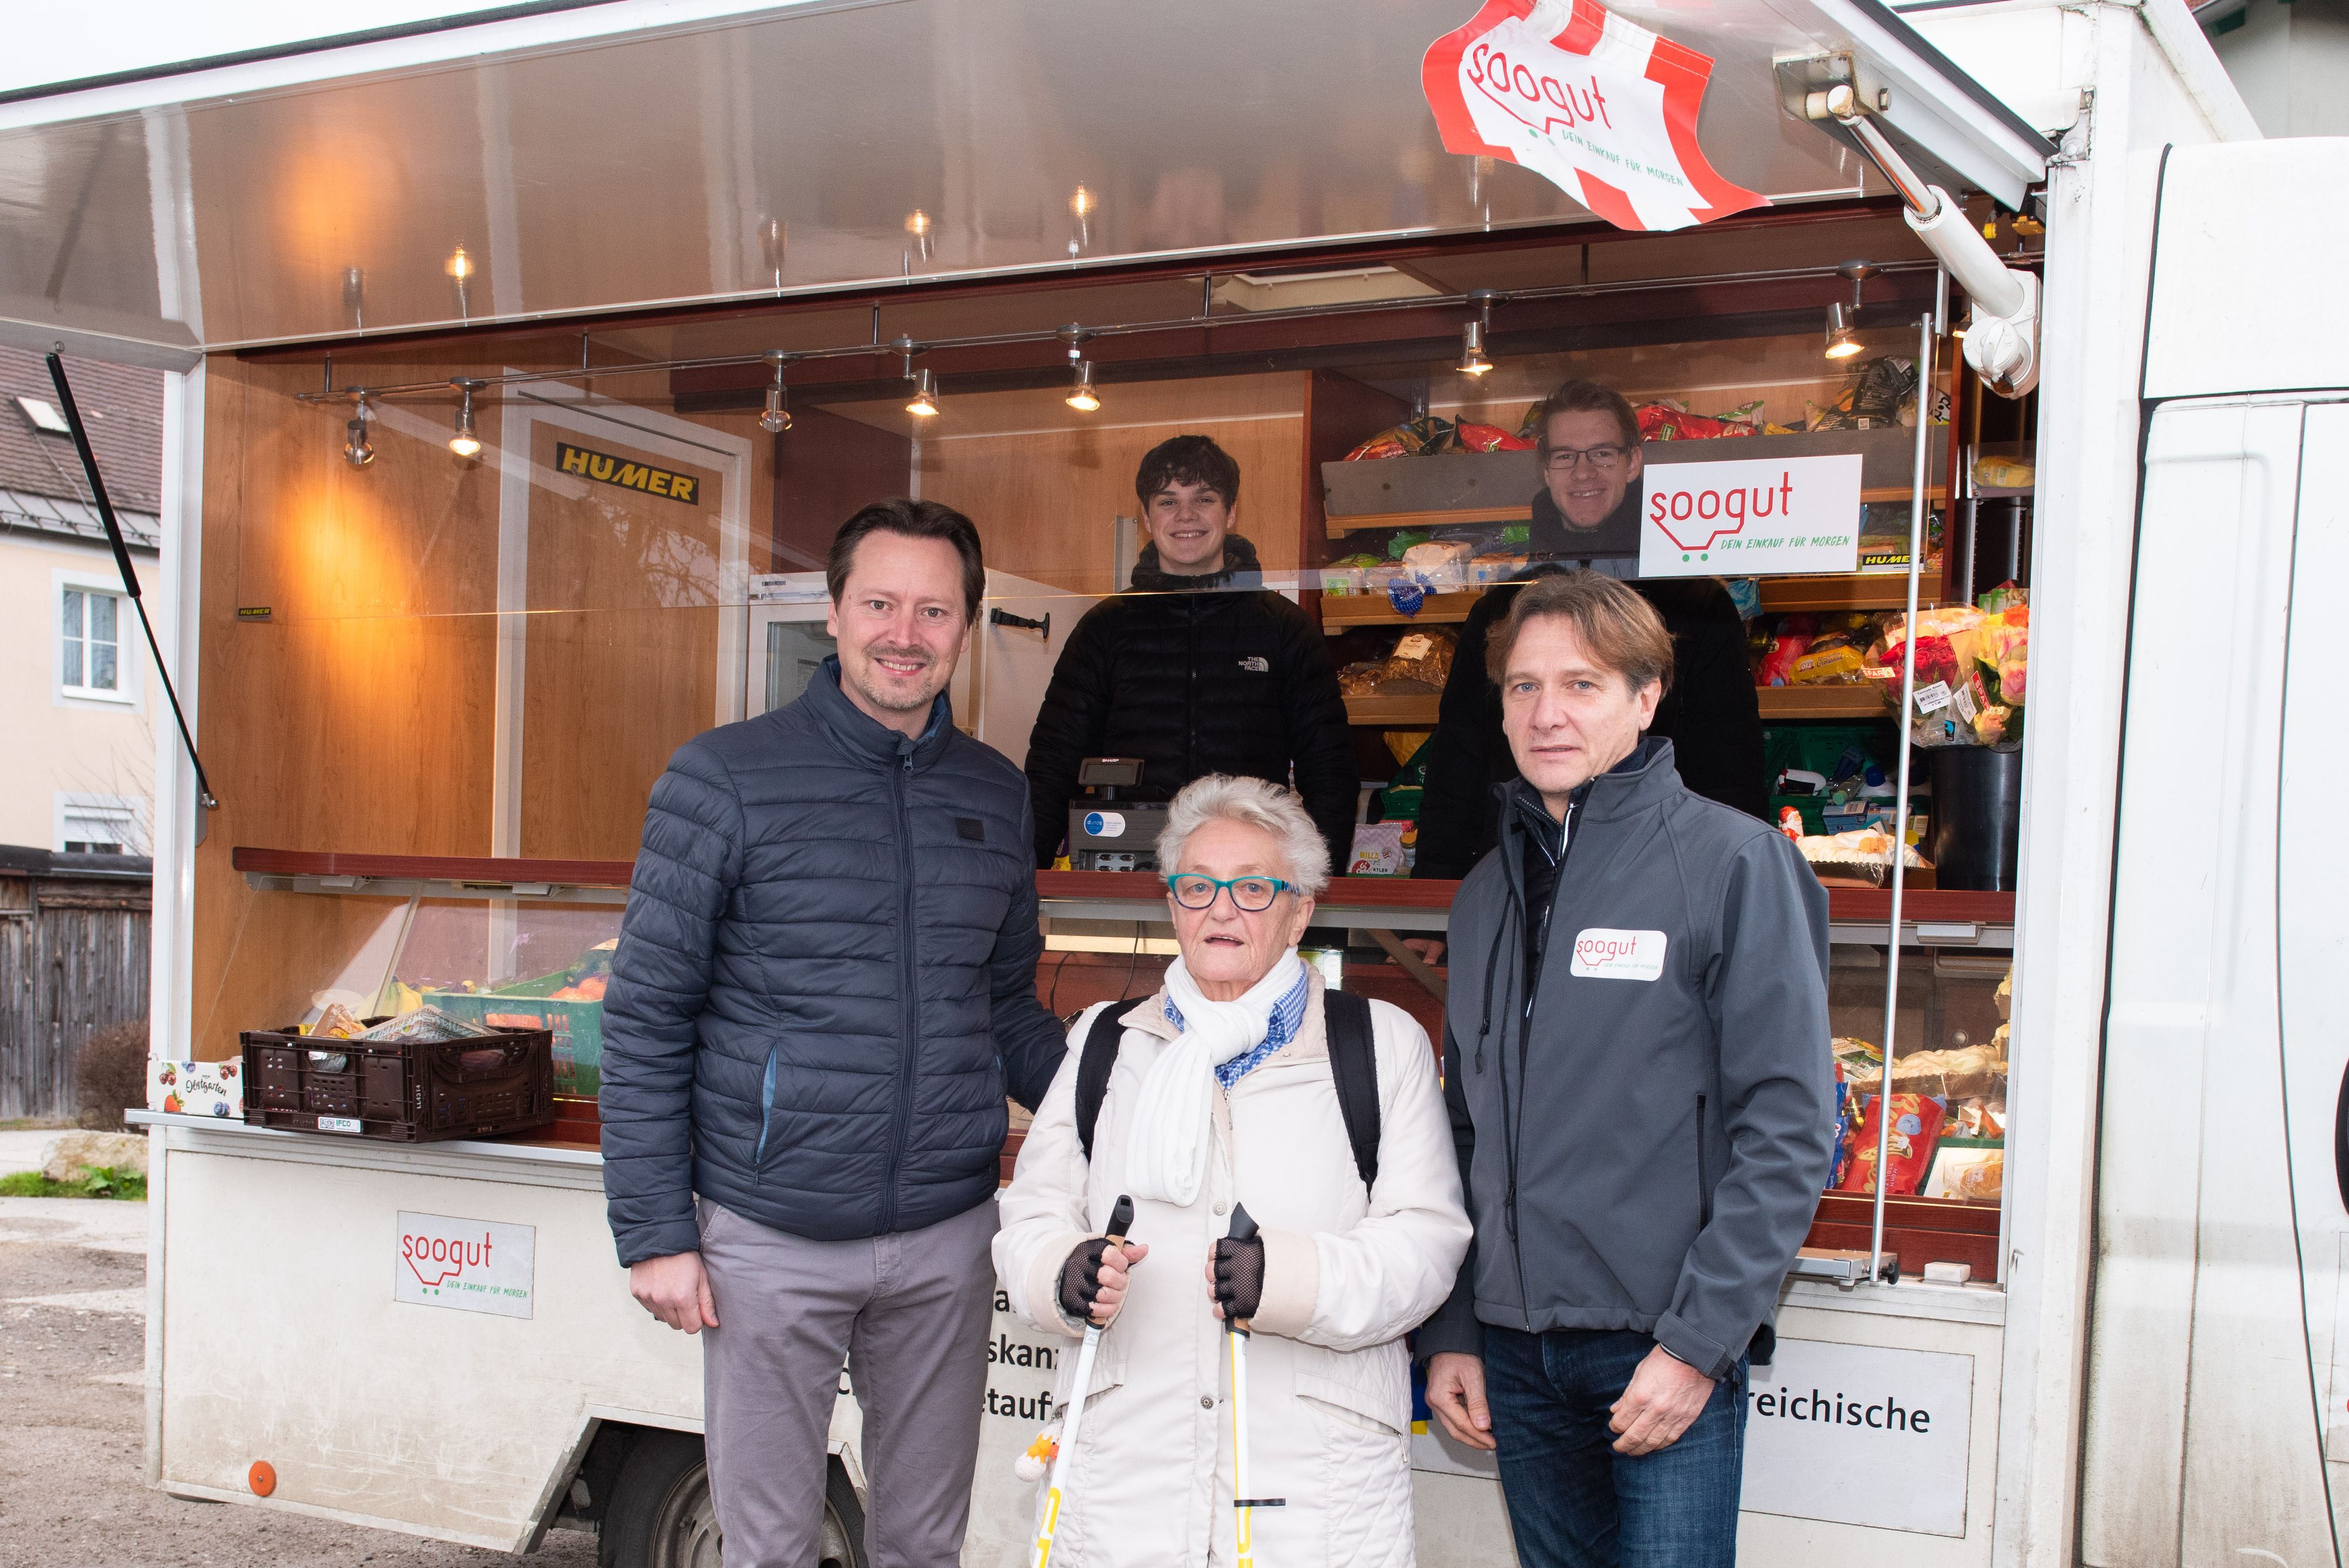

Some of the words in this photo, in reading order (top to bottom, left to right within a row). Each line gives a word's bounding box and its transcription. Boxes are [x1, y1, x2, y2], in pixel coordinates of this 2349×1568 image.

[1467, 43, 1611, 130] soogut
[1562, 129, 1583, 146] DEIN
[1587, 140, 1620, 164] EINKAUF
[1626, 159, 1642, 173] FÜR
[1646, 166, 1684, 187] MORGEN
[562, 447, 694, 500] HUMER
[1649, 472, 1793, 534] soogut
[1721, 539, 1742, 550] DEIN
[1746, 537, 1785, 549] EINKAUF
[1789, 536, 1806, 547] FÜR
[1810, 536, 1850, 547] MORGEN
[1865, 555, 1910, 564] HUME
[1577, 936, 1637, 960] soogut
[186, 1078, 227, 1096] Obstgarten
[402, 1231, 493, 1277] soogut
[446, 1280, 460, 1289] DEIN
[463, 1282, 487, 1292] EINKAUF
[490, 1285, 501, 1294] FÜR
[503, 1288, 528, 1298] MORGEN
